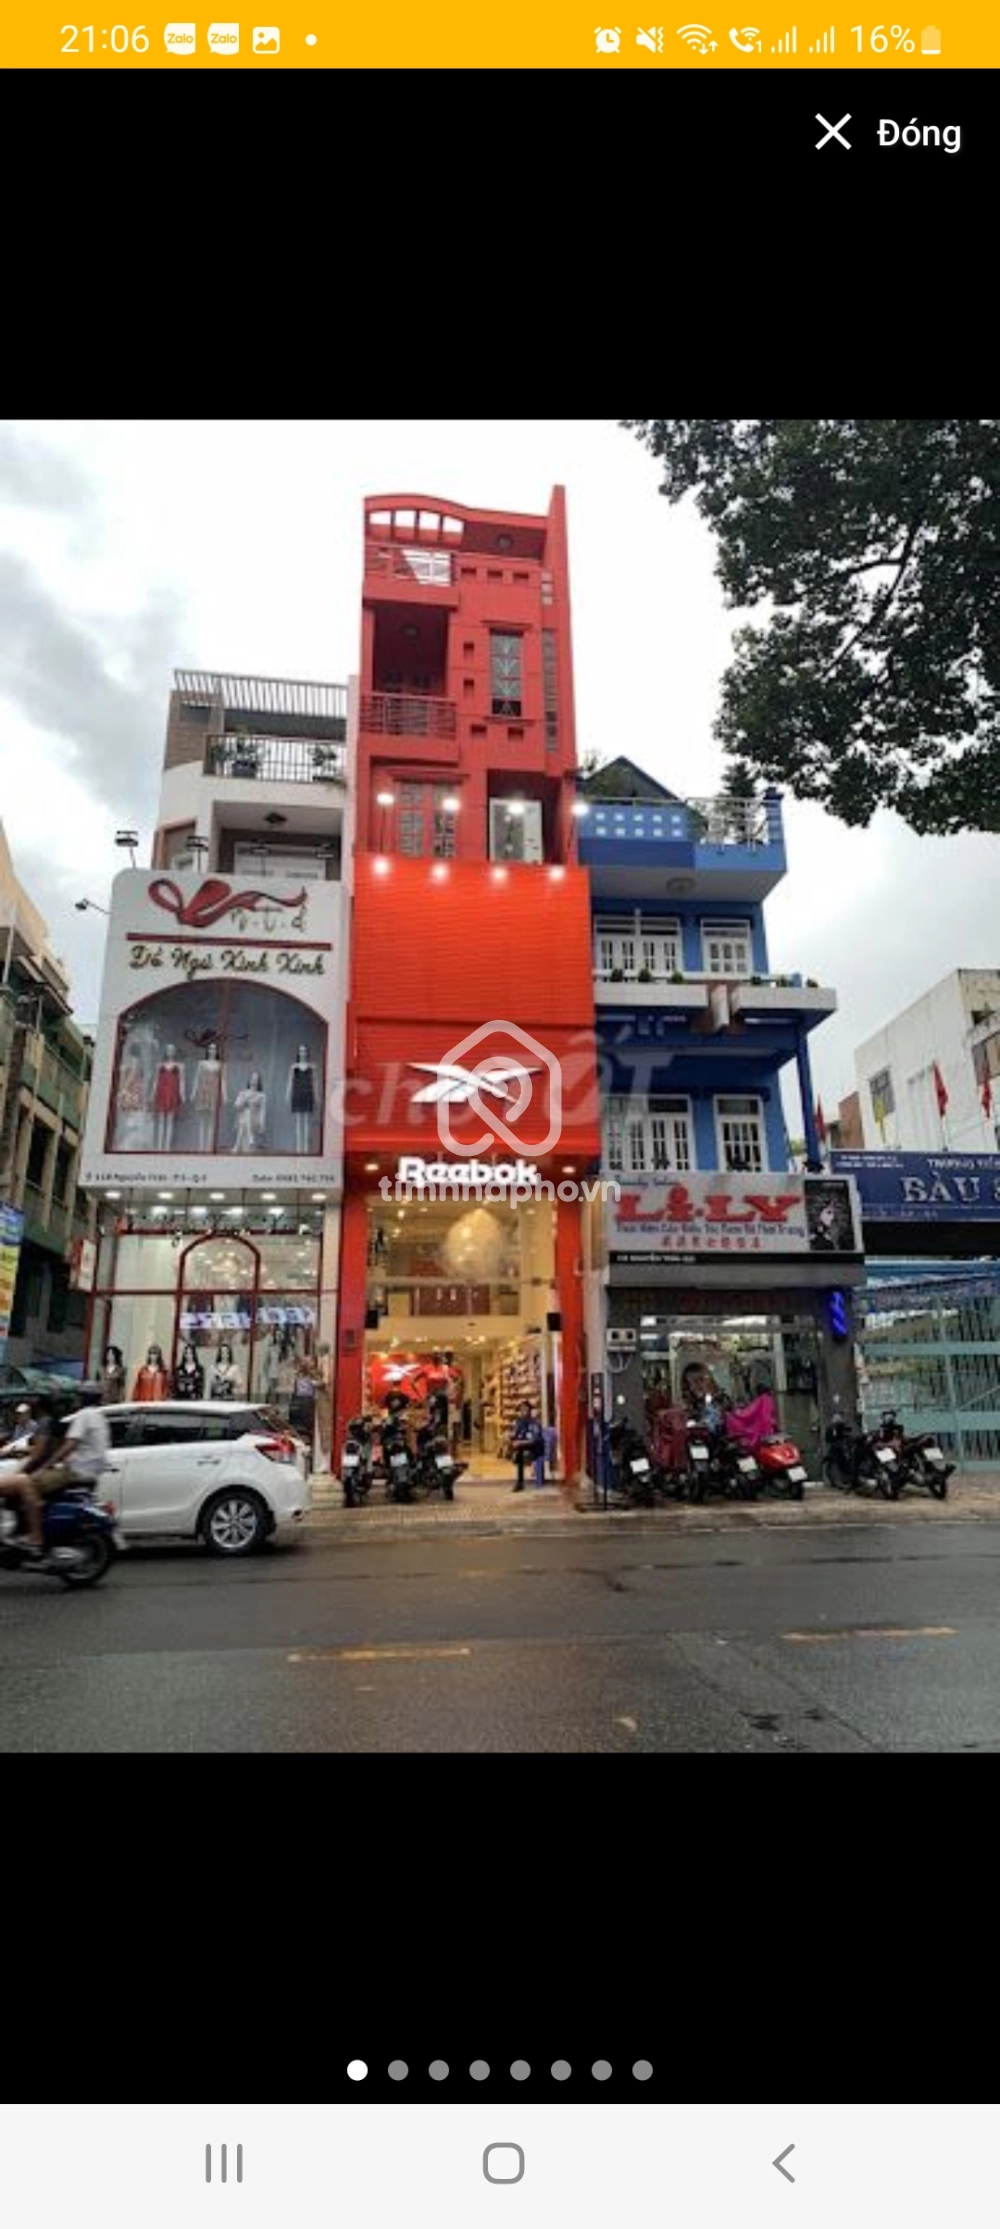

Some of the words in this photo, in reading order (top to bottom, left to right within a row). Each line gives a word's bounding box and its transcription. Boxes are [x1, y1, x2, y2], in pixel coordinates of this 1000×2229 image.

[60, 24, 150, 54] 21:06
[167, 33, 194, 44] Zalo
[210, 33, 237, 44] Zalo
[850, 25, 915, 53] 16%
[877, 117, 961, 154] Đóng
[398, 1156, 540, 1188] Reebok
[901, 1170, 981, 1203] BÀU
